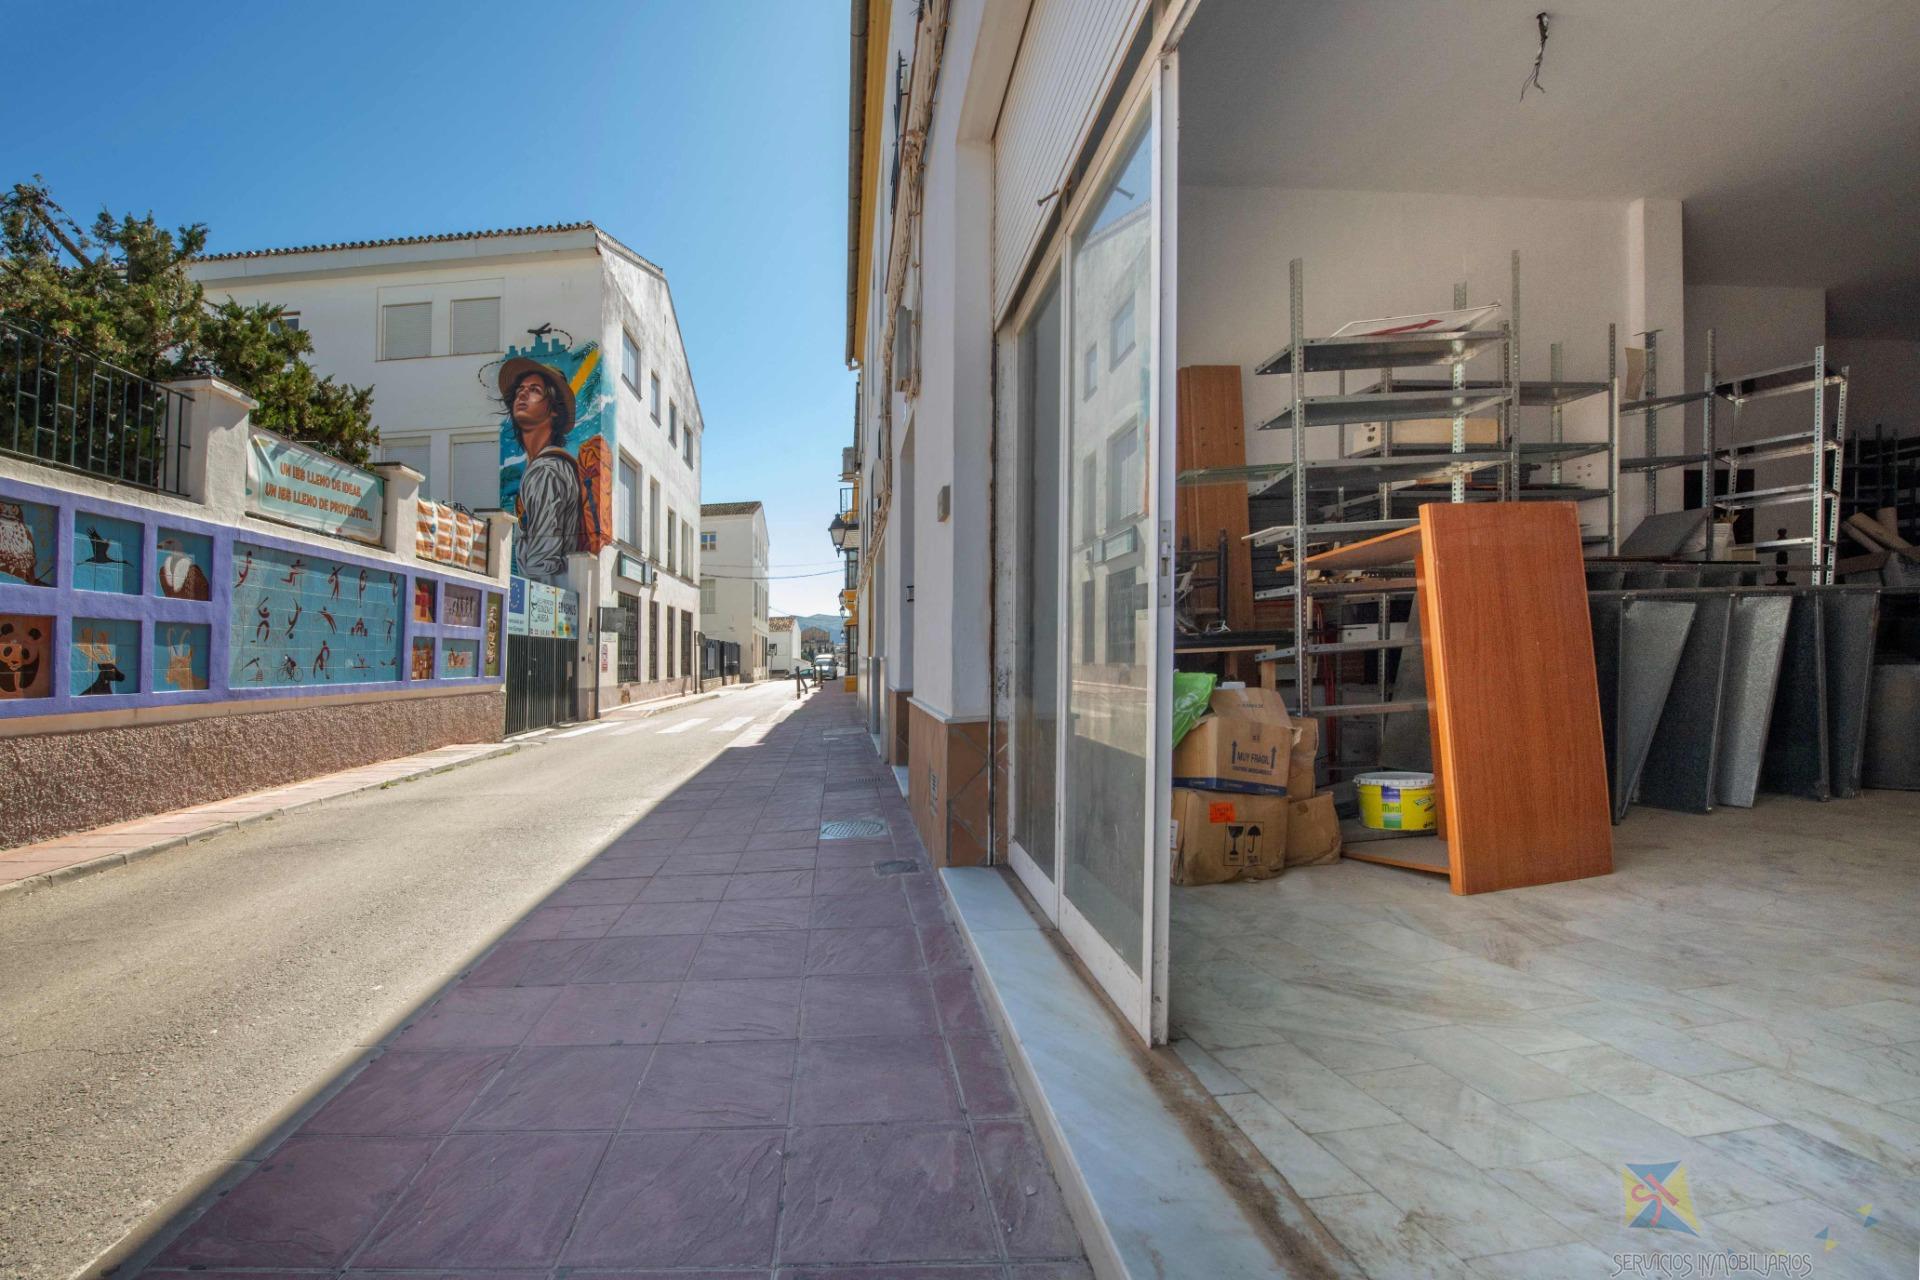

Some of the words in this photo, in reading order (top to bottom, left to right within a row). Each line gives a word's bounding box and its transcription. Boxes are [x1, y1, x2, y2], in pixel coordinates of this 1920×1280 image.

[280, 462, 291, 476] UN
[293, 465, 305, 481] IES
[307, 470, 331, 488] LLENO
[332, 478, 341, 490] DE
[265, 482, 277, 497] UN
[278, 486, 291, 502] IES
[293, 490, 317, 507] LLENO
[319, 498, 329, 511] DE
[1237, 751, 1250, 762] MUY
